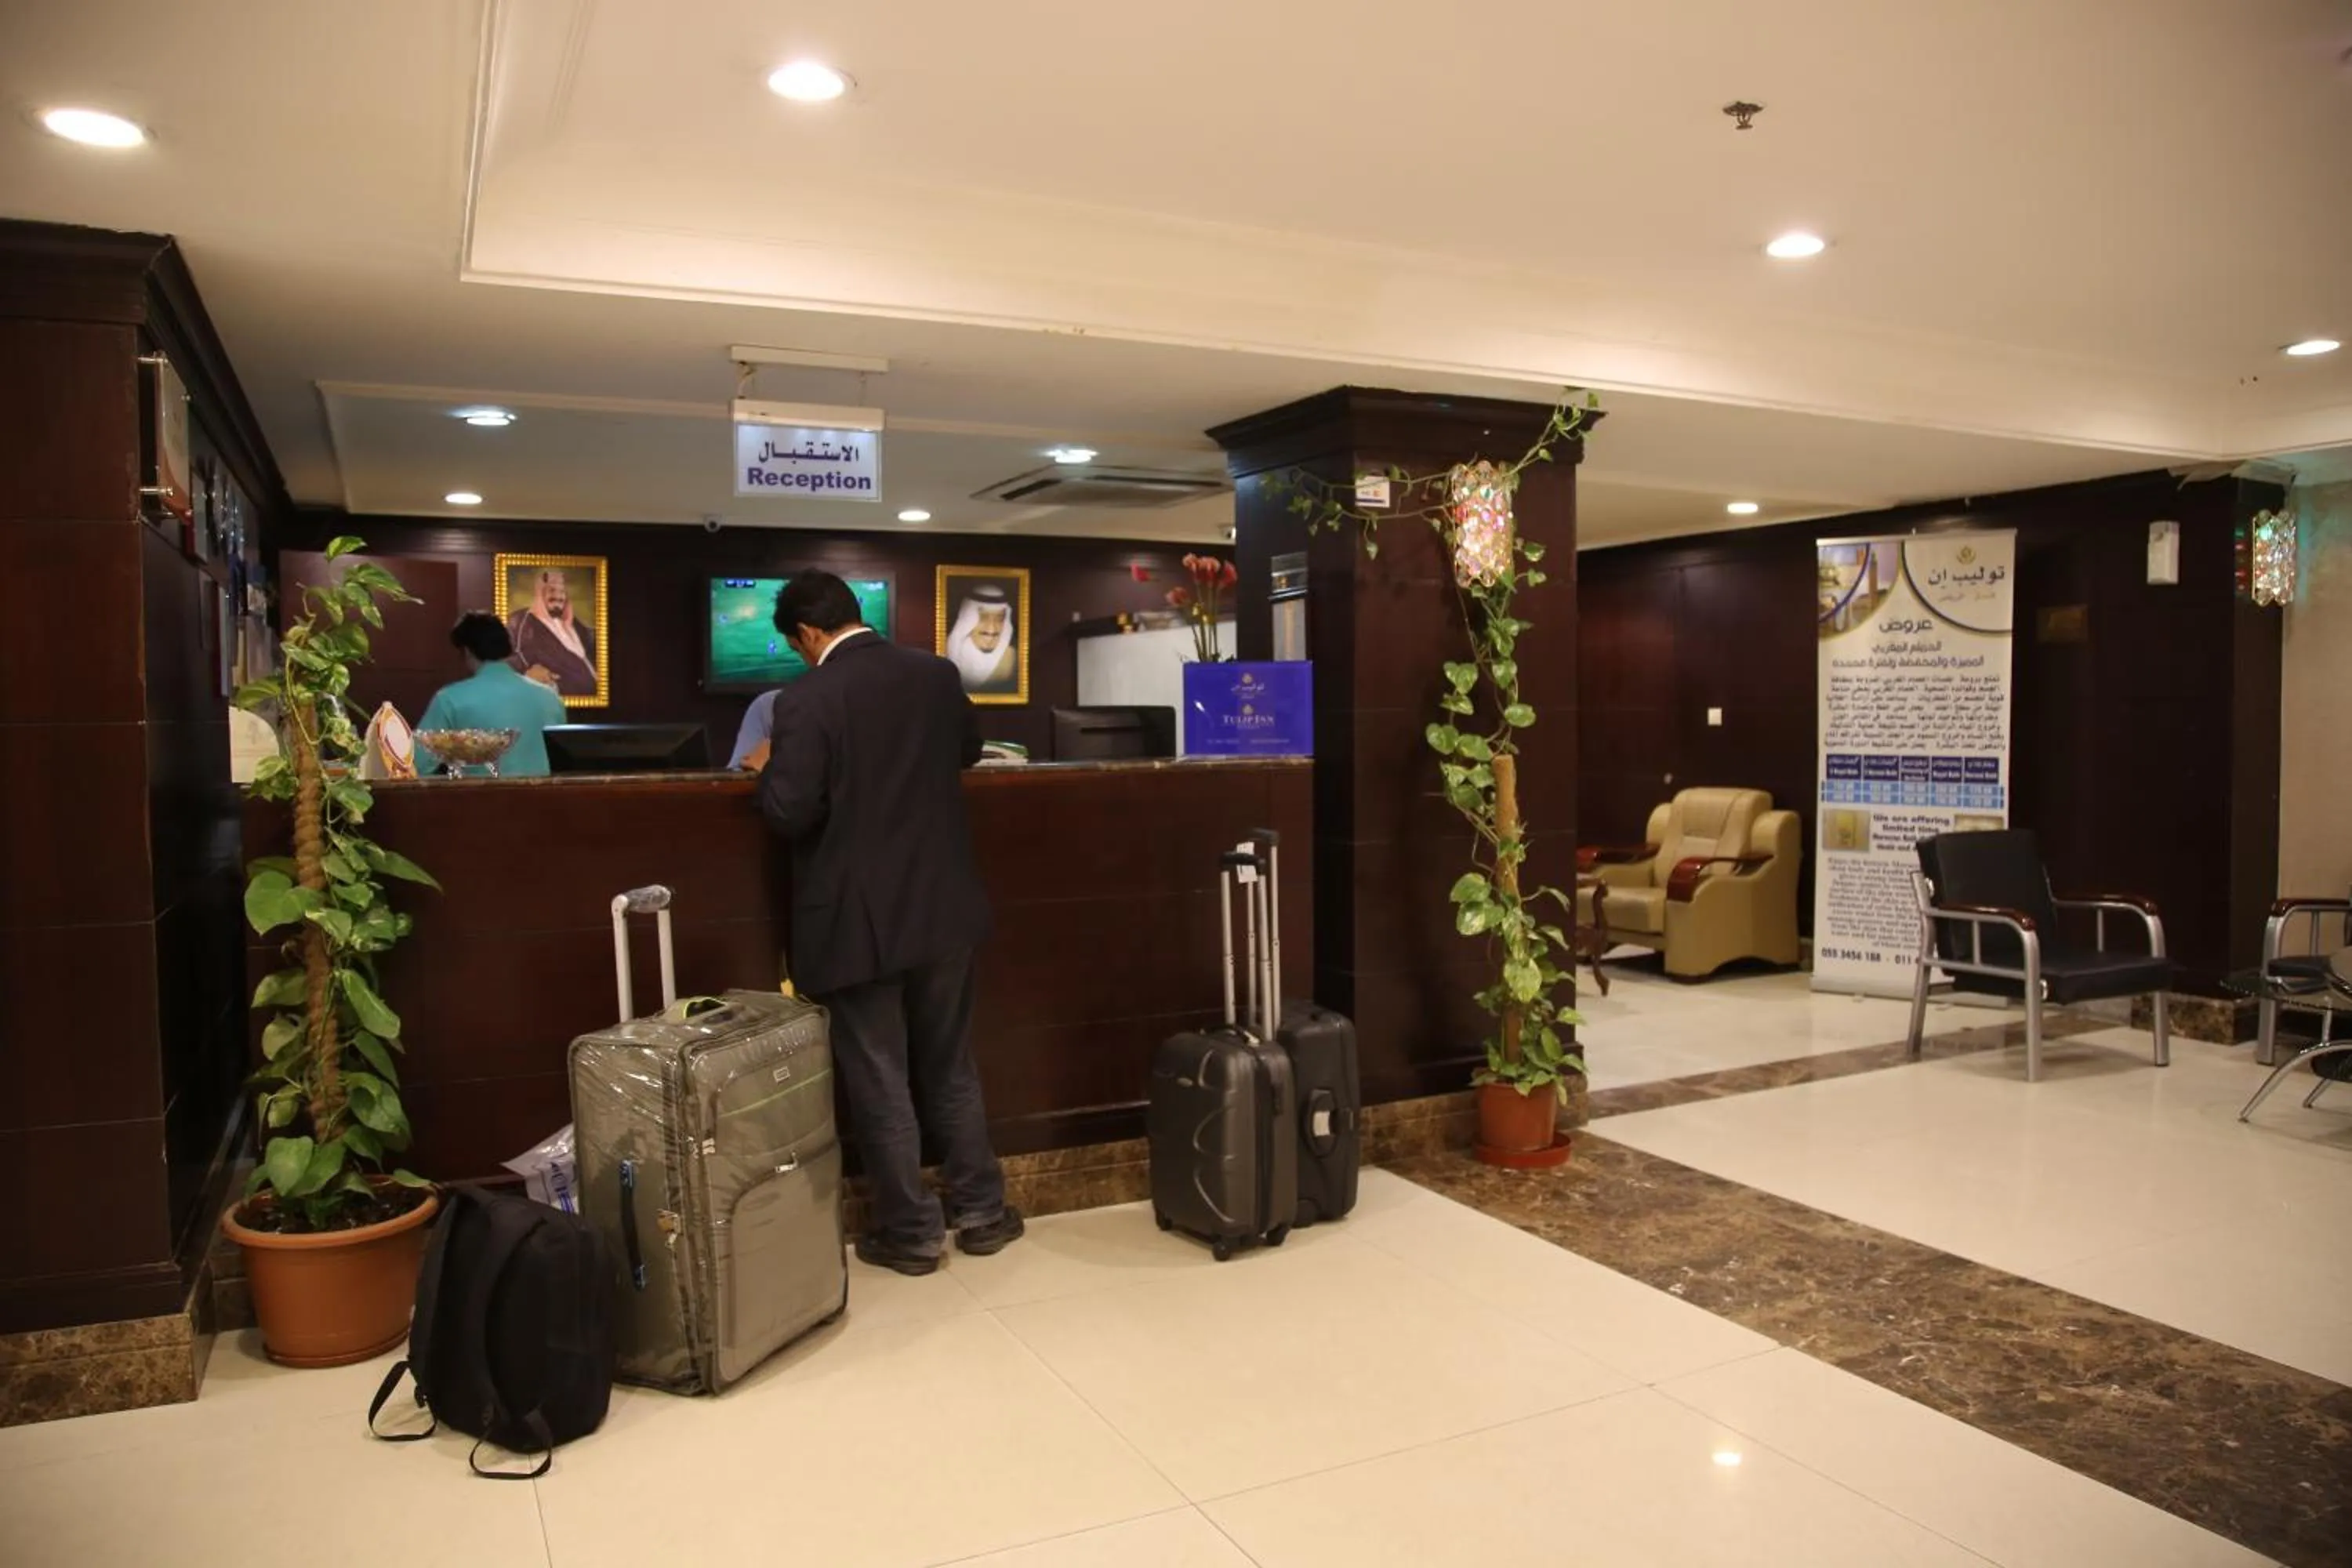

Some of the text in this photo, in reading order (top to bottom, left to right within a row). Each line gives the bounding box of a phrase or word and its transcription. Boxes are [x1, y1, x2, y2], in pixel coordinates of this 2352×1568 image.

[758, 441, 859, 464] الاستقبال
[747, 467, 872, 492] Reception
[1879, 619, 1933, 633] عروض
[1911, 815, 1950, 826] offering
